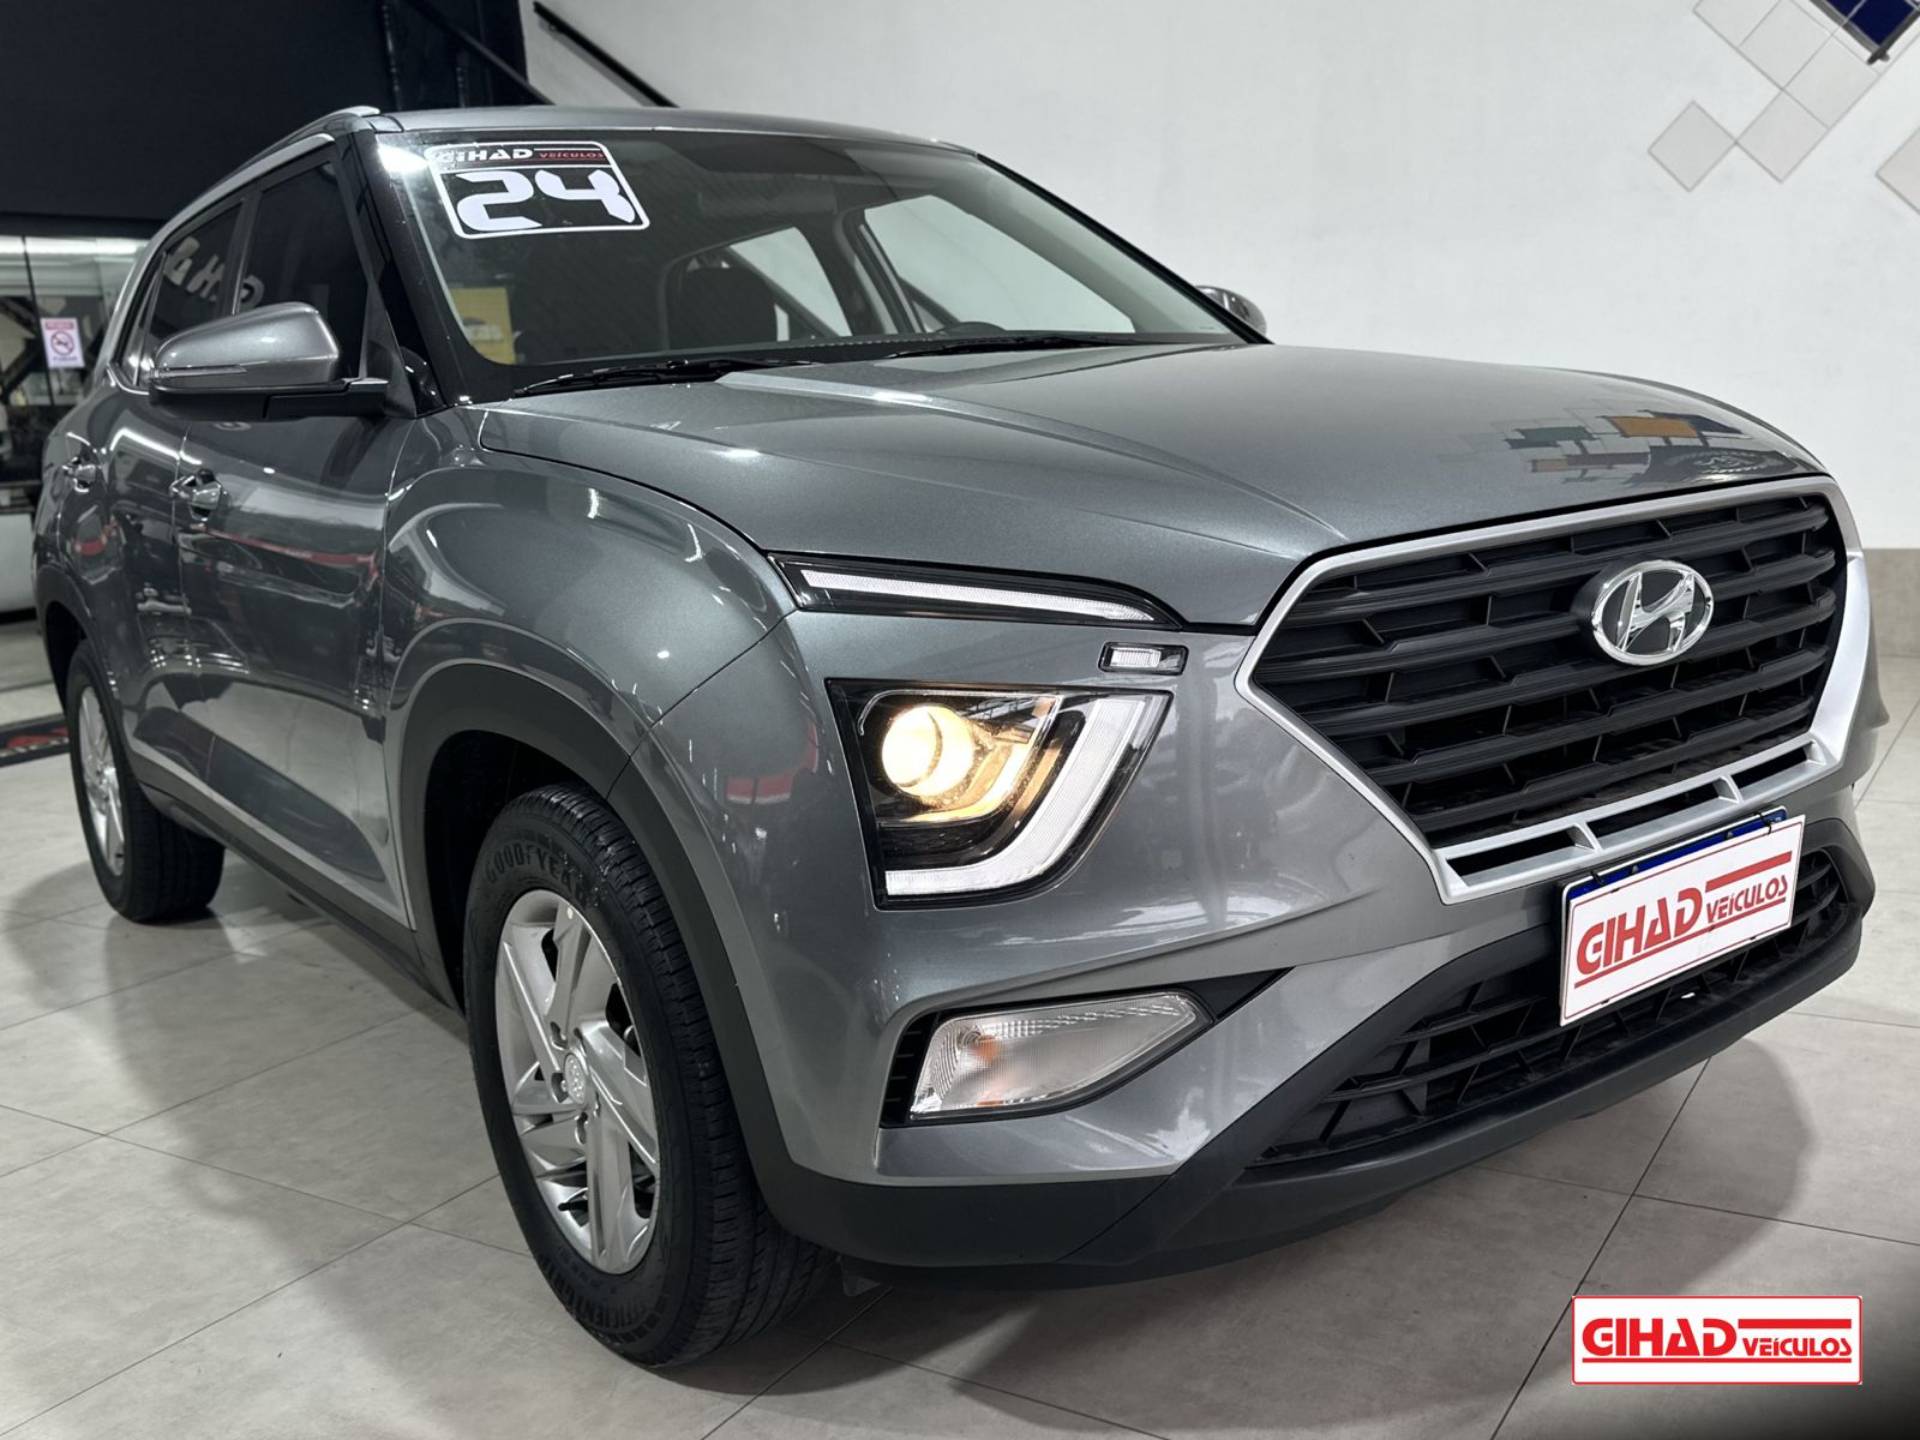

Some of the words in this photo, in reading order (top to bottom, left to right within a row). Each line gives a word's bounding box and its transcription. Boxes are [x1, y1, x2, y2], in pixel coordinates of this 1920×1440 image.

[456, 169, 636, 232] 24
[1576, 887, 1703, 976] GIHAD
[1706, 874, 1788, 923] VEÍCULOS
